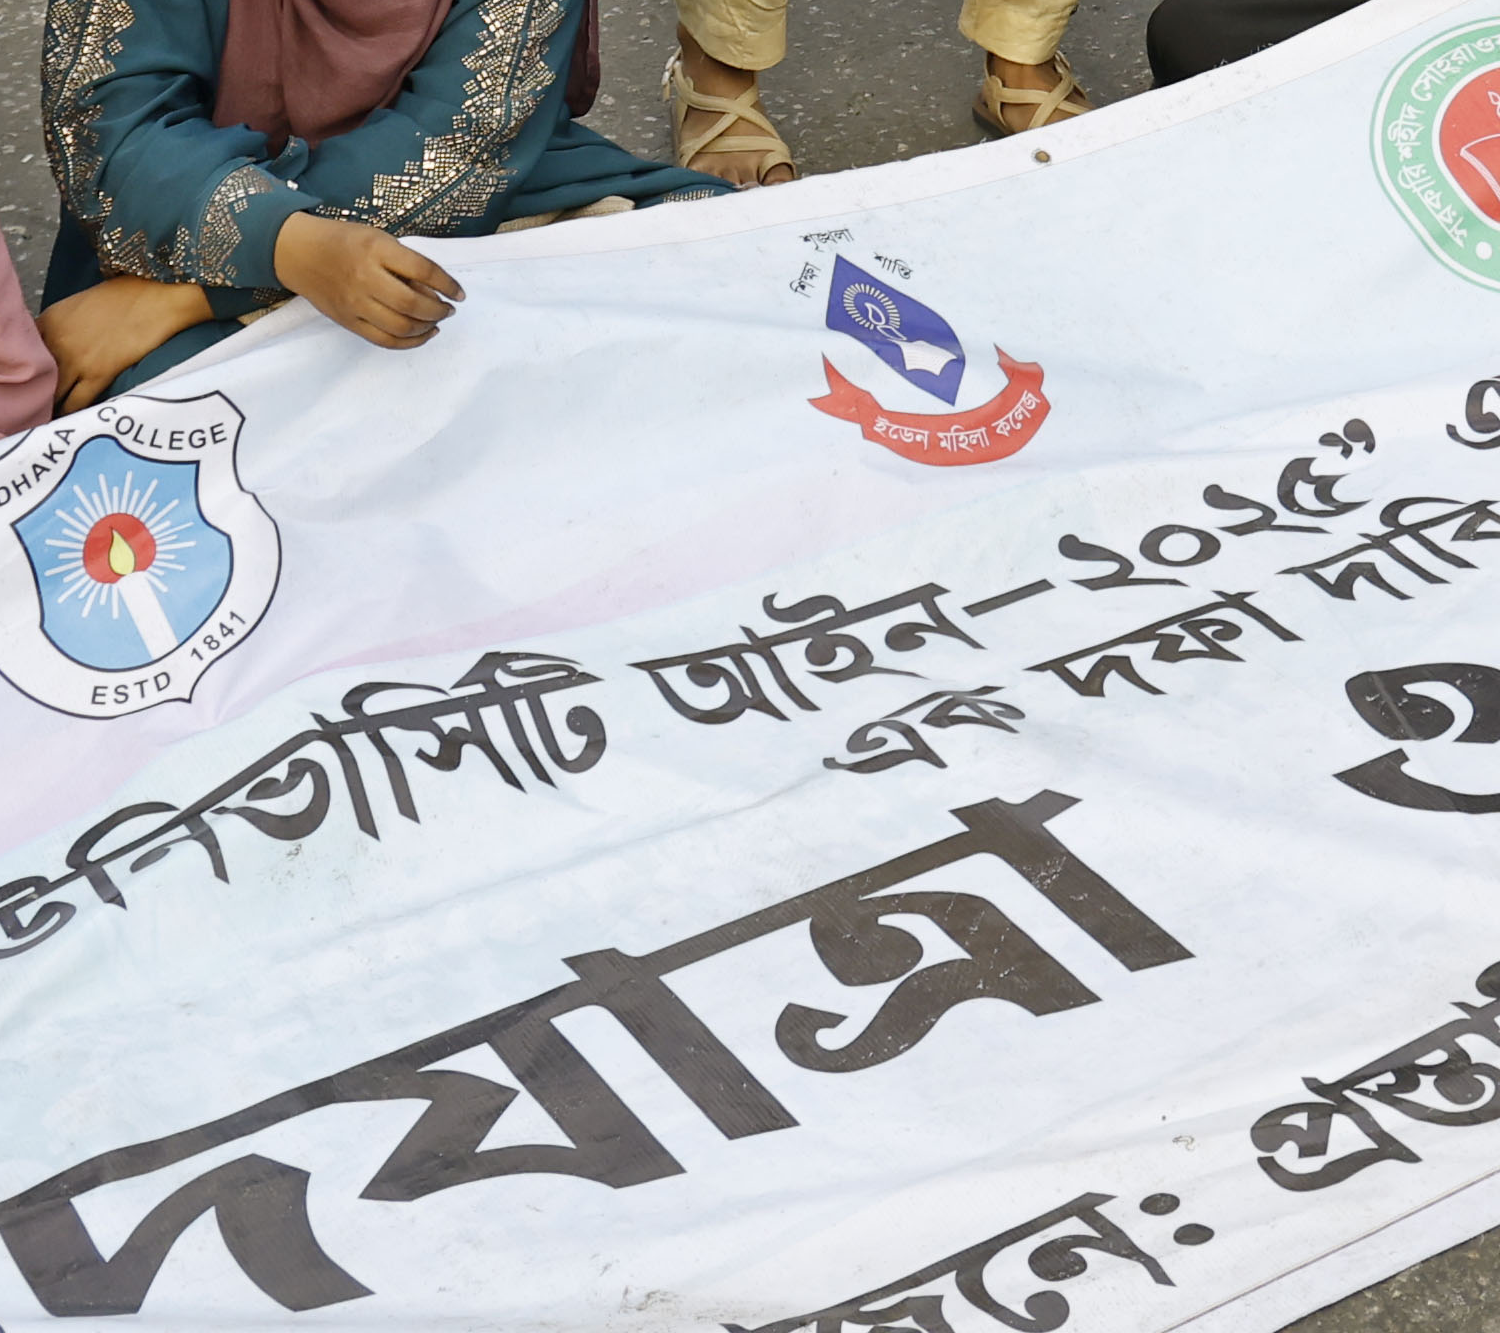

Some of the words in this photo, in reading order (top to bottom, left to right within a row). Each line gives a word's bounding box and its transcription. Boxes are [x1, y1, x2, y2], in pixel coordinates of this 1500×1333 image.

[1387, 102, 1422, 162] শহীদ
[1397, 162, 1469, 249] সরকারি
[97, 405, 229, 451] COLLEGE
[872, 416, 930, 450] ইডেন
[936, 425, 991, 453] মহিলা
[991, 390, 1042, 438] কলেজ
[90, 671, 173, 706] ESTD
[190, 610, 247, 663] 1841
[822, 683, 1027, 775] এক
[1026, 589, 1305, 700] দফা
